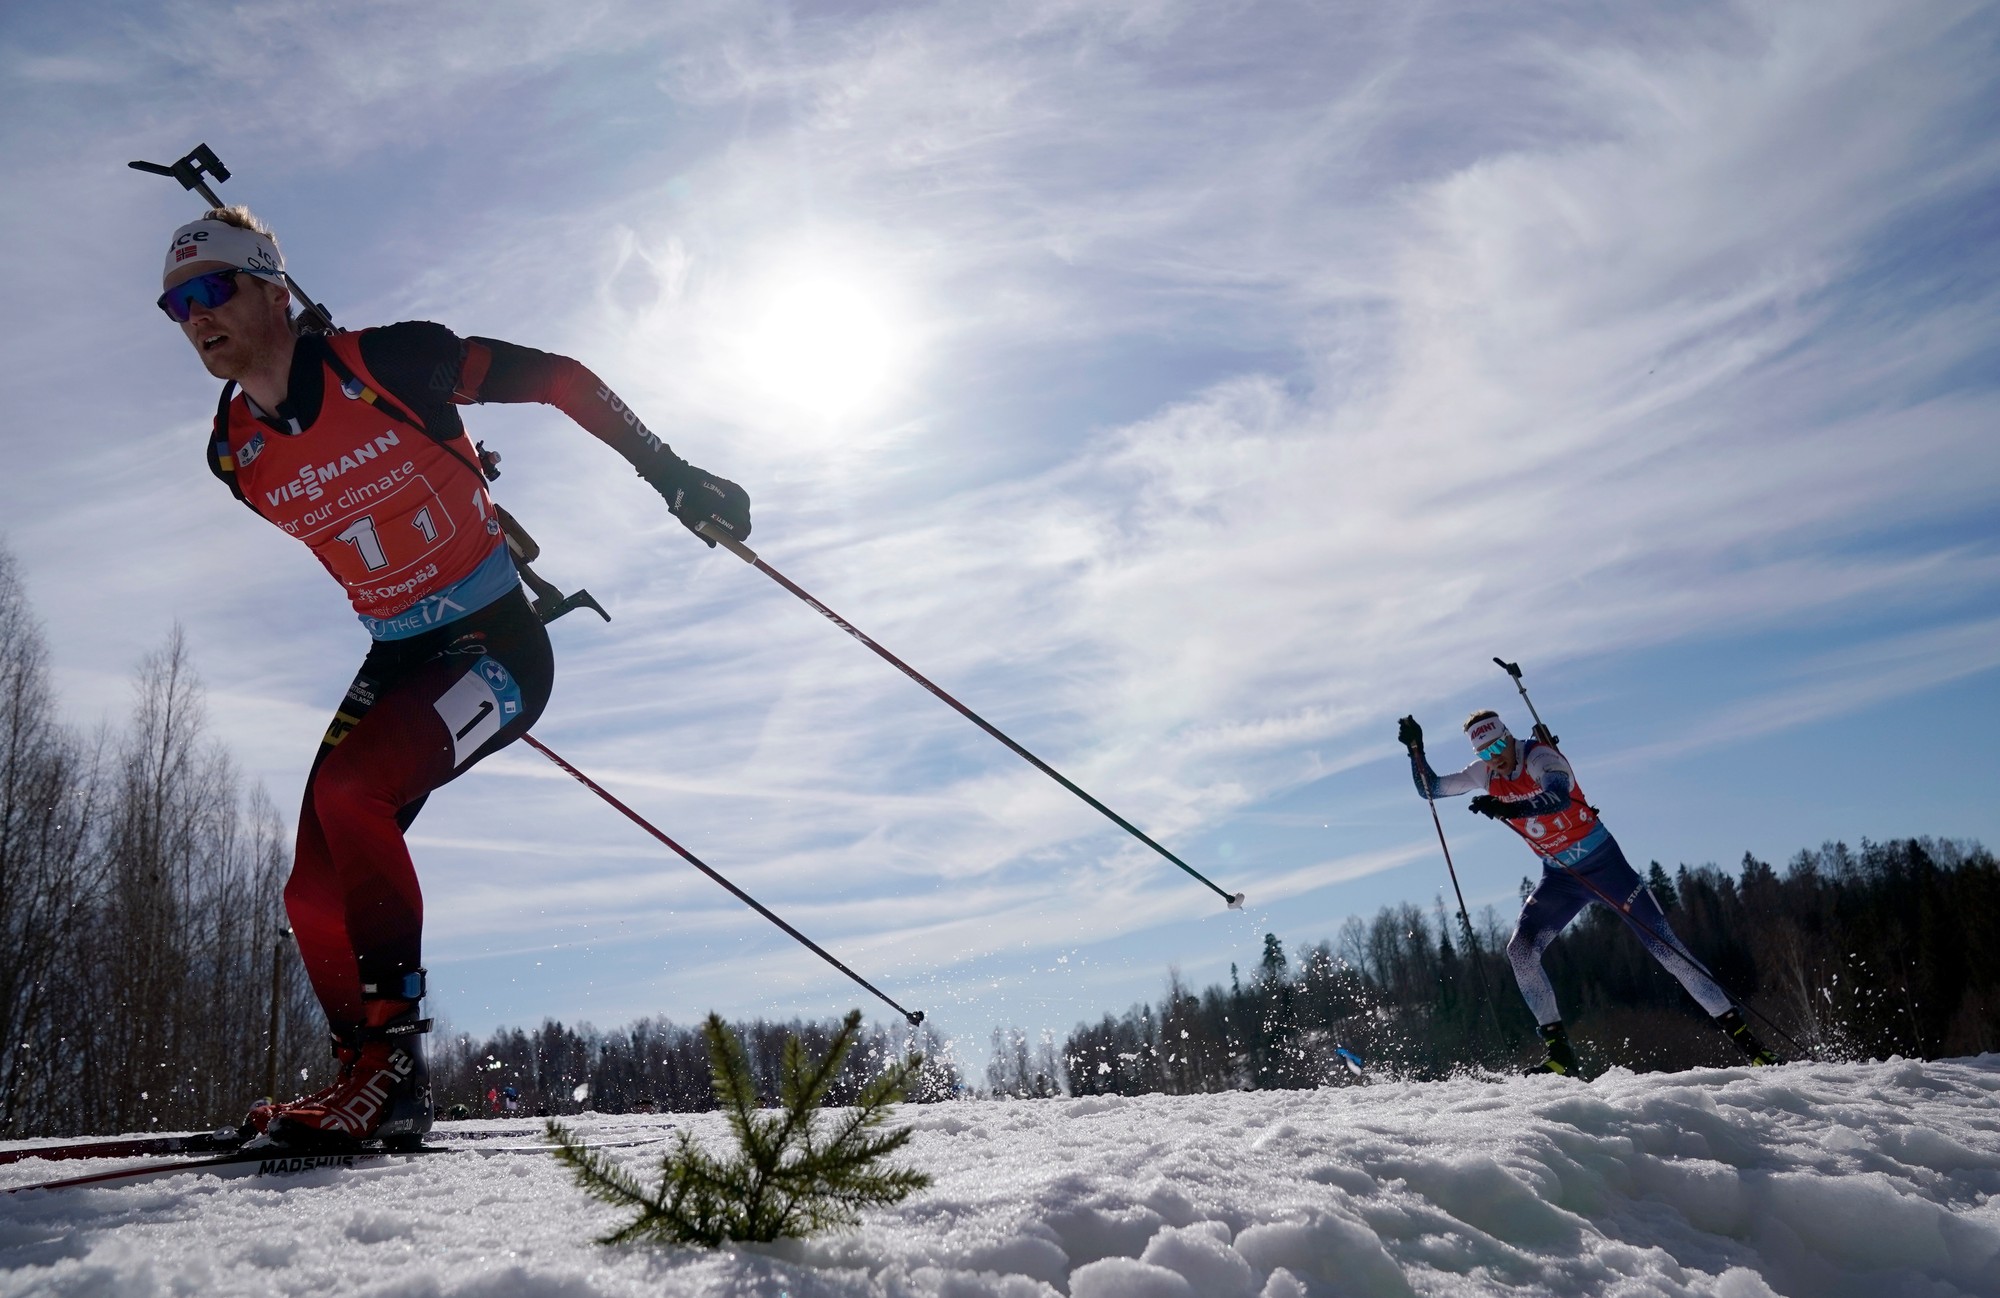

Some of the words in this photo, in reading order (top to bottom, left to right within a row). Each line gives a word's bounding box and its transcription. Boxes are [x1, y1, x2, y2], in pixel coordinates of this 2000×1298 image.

[169, 231, 209, 254] ice
[596, 381, 663, 453] NORGE
[265, 429, 400, 507] VIESSMANN
[277, 520, 299, 535] for
[303, 501, 333, 526] our
[337, 460, 415, 509] climate
[471, 488, 487, 522] 1
[334, 514, 389, 573] 1
[411, 505, 438, 544] 1
[375, 562, 439, 598] Otepää
[387, 615, 422, 633] THE
[455, 700, 494, 742] 1
[1470, 722, 1496, 740] AVANT
[1529, 790, 1561, 809] FIN
[1579, 808, 1588, 822] 6
[1525, 816, 1547, 838] 6
[1553, 816, 1565, 830] 1
[385, 1024, 415, 1034] alpina
[320, 1048, 414, 1131] alpina
